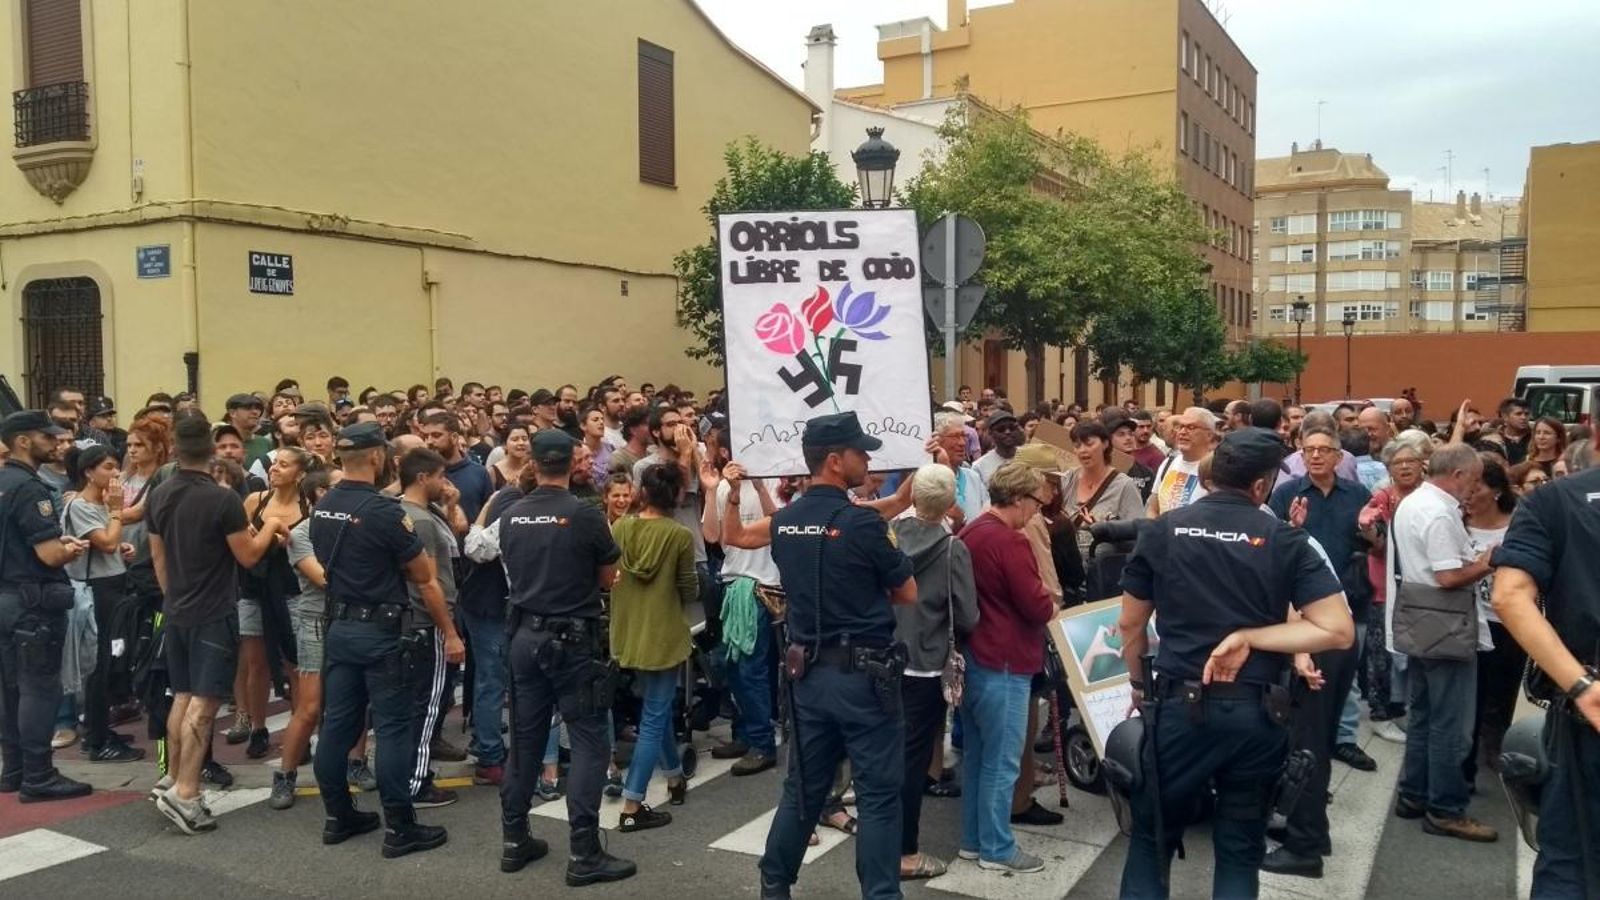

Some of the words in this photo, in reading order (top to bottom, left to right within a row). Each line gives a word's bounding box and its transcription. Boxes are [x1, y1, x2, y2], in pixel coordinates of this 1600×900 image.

[252, 254, 290, 268] CALLE
[266, 268, 277, 277] DE
[818, 259, 849, 282] DE
[314, 510, 352, 522] POLICIA
[511, 515, 558, 525] POLICIA
[777, 525, 830, 535] POLICIA
[1174, 526, 1250, 542] POLICIA
